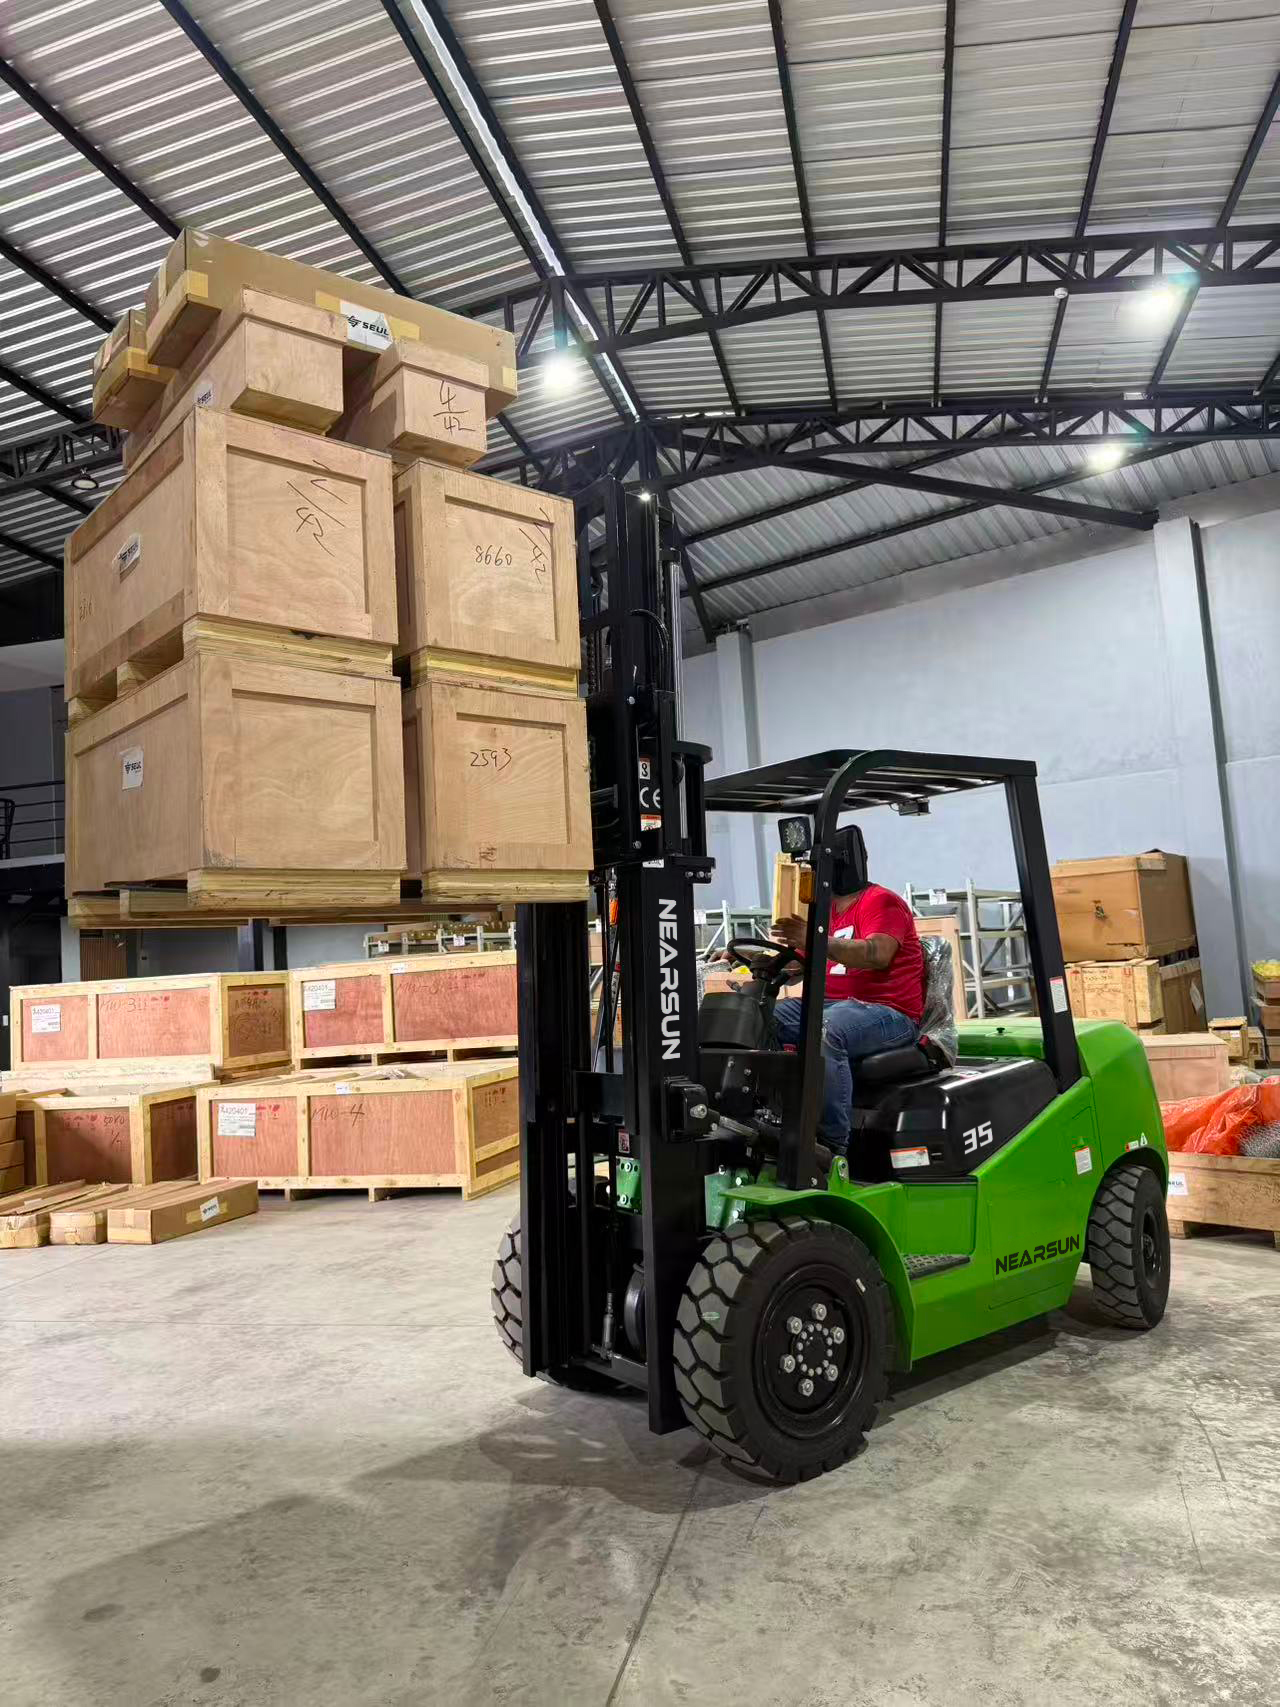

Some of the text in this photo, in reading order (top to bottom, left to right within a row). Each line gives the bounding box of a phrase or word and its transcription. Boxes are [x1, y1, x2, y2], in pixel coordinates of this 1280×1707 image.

[362, 321, 389, 336] SEUL
[470, 747, 512, 772] 2593
[658, 898, 681, 1060] NEARSUN
[962, 1120, 993, 1155] 35
[995, 1233, 1080, 1275] NEARSUN
